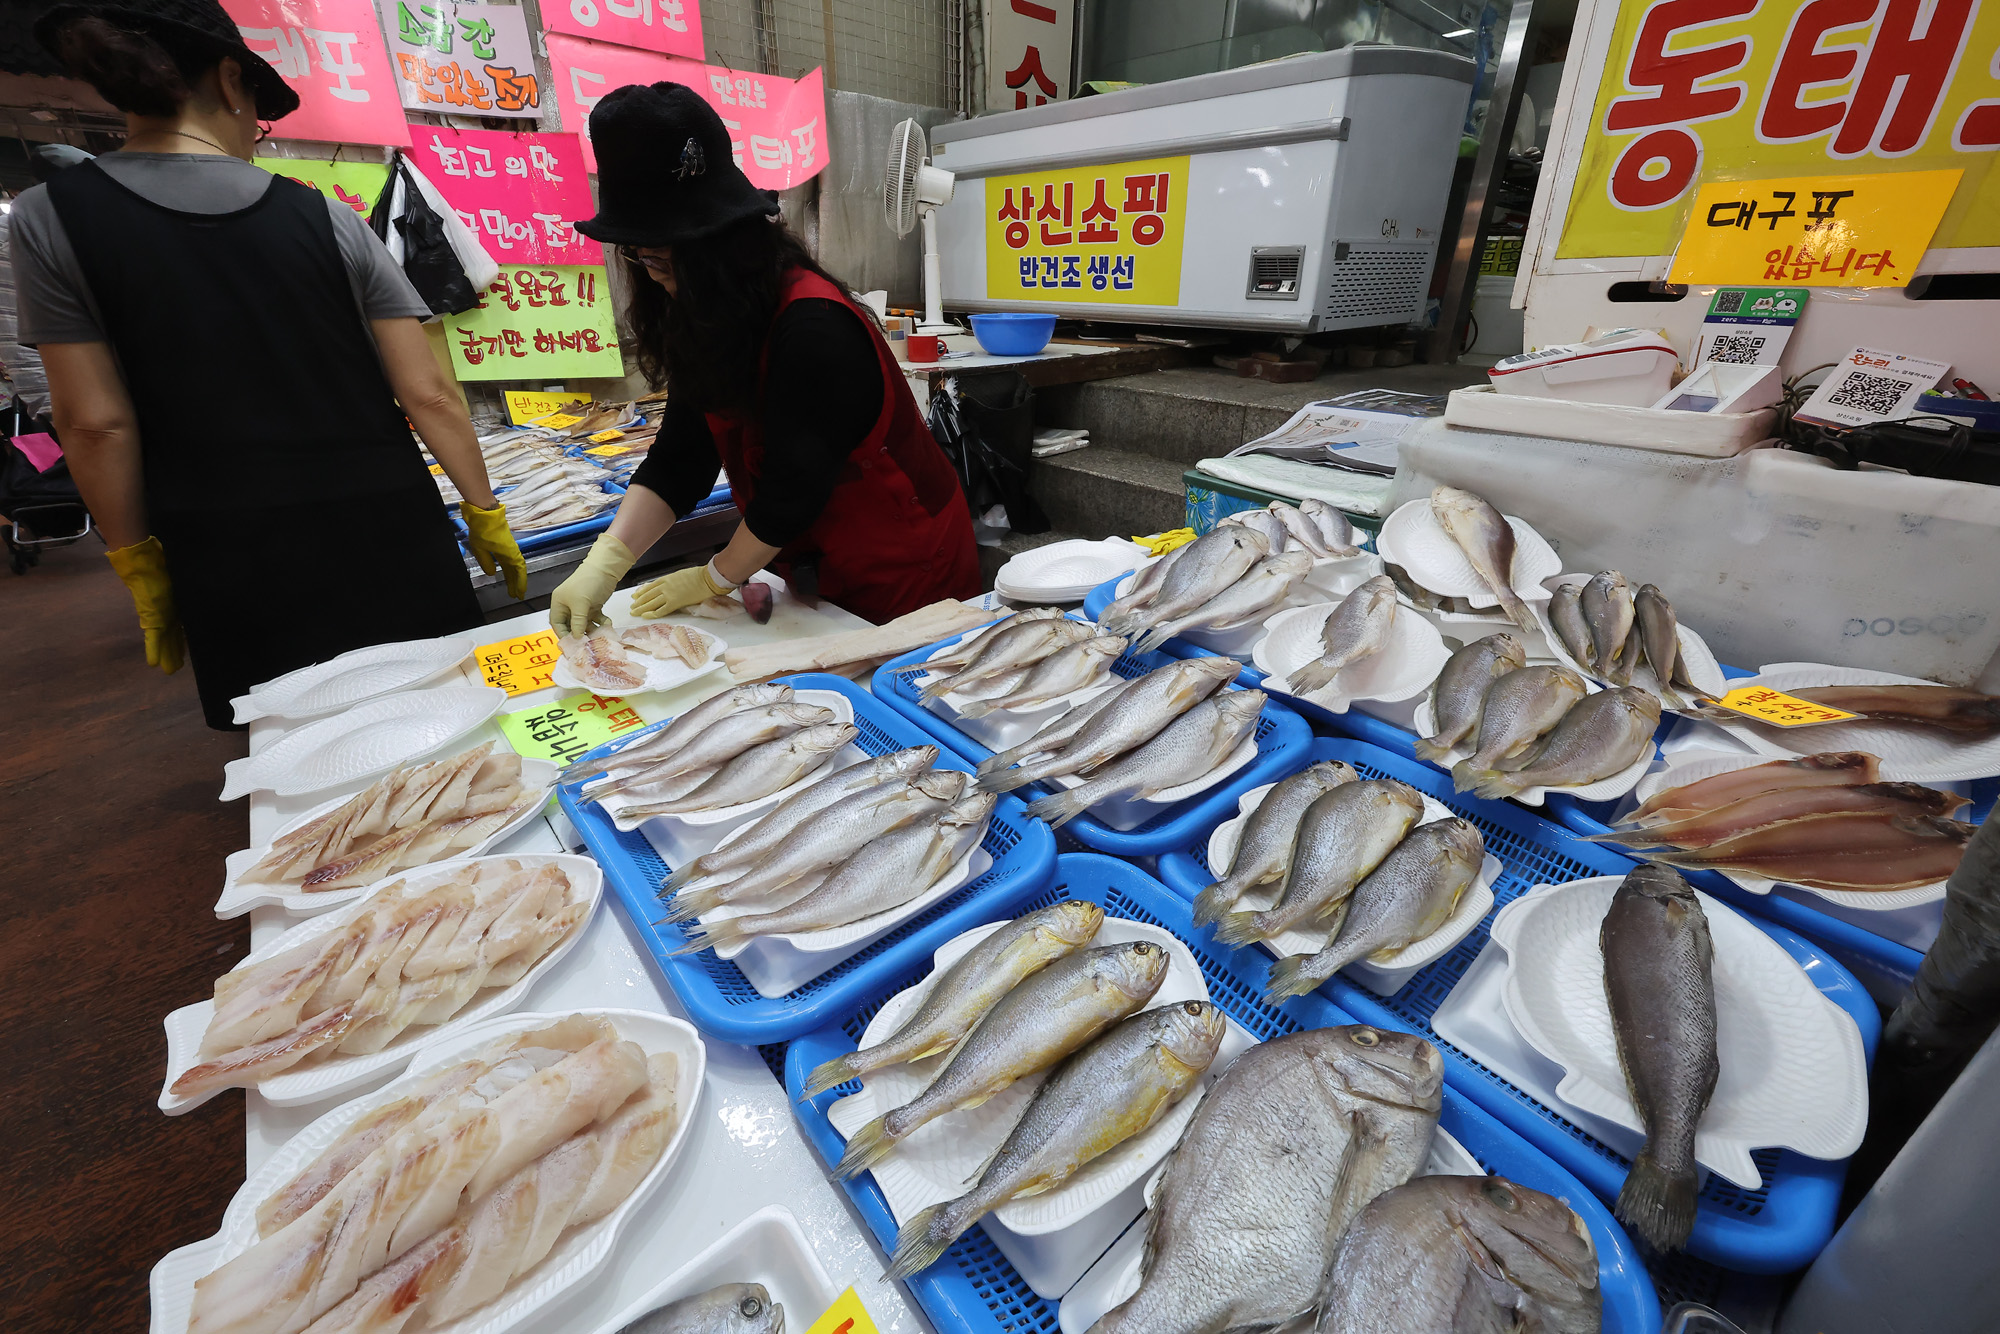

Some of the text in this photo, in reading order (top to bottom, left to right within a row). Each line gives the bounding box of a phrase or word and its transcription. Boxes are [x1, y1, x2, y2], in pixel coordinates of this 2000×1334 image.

[397, 52, 493, 110] 맛있는
[483, 63, 540, 111] 조기
[710, 74, 767, 109] 맛있는
[722, 115, 818, 173] 태포
[998, 173, 1169, 249] 상신쇼핑
[1706, 189, 1855, 232] 대구포
[1019, 255, 1135, 291] 반건조 생선
[1763, 245, 1900, 282] 있습니다.
[456, 326, 528, 365] 굽기만
[1849, 354, 1891, 368] 온누리
